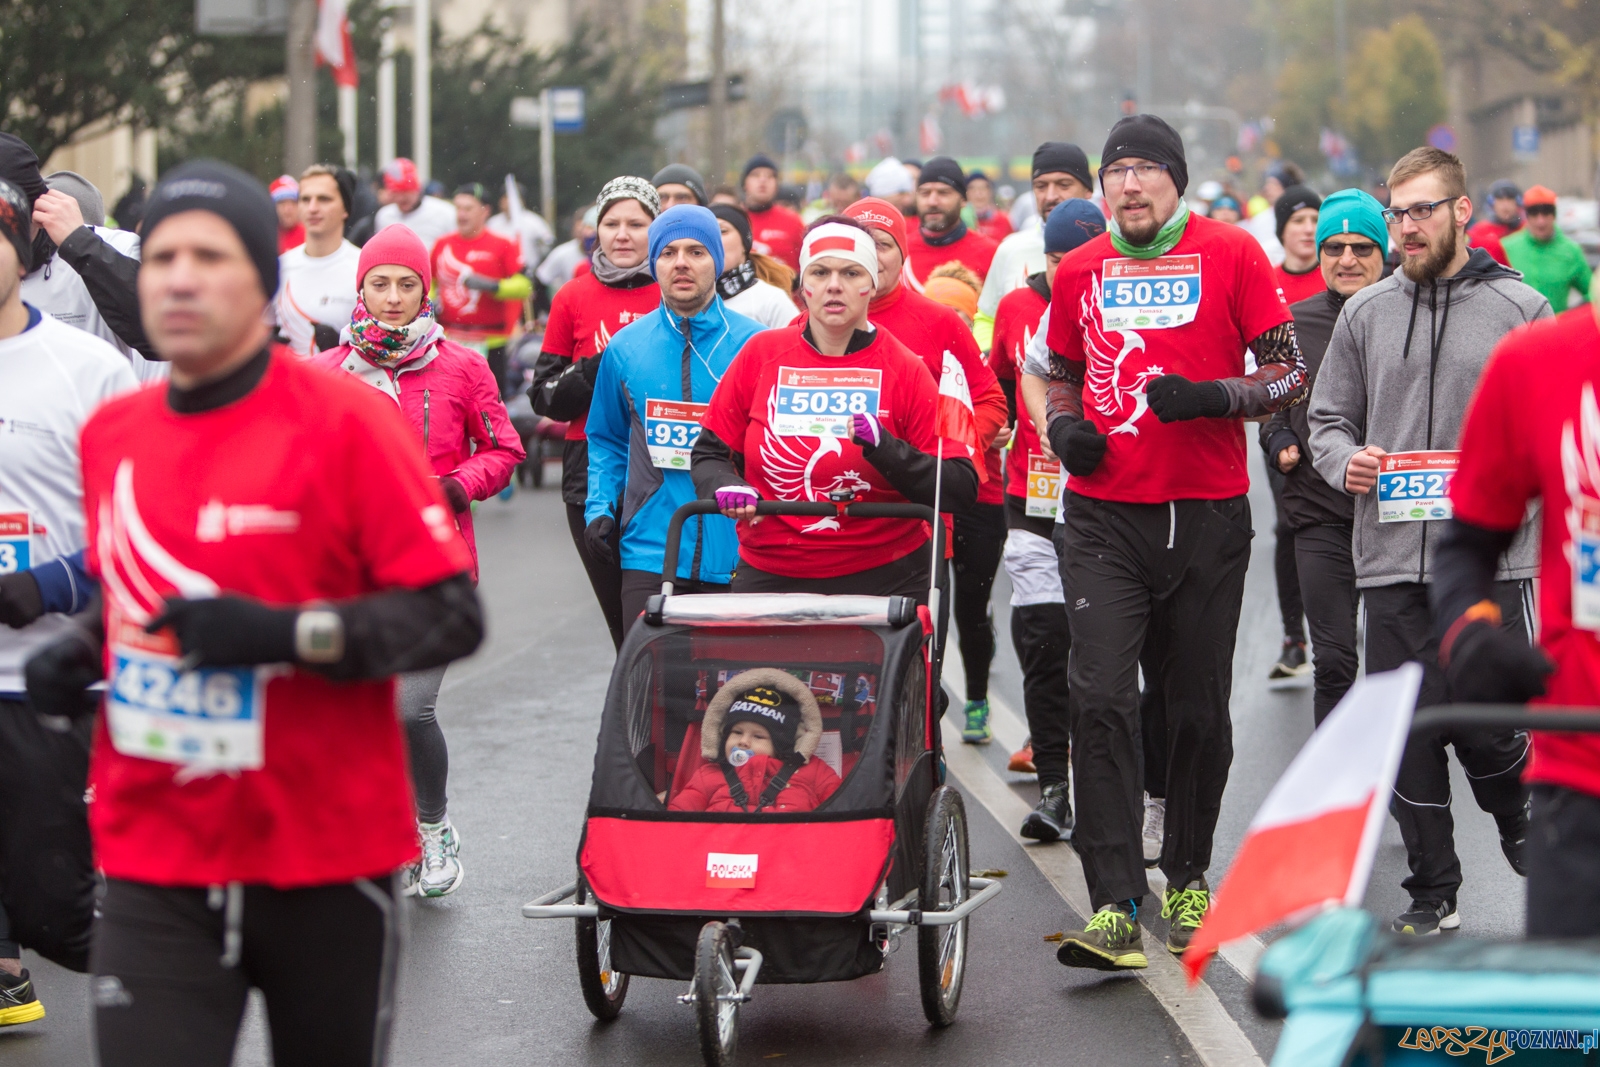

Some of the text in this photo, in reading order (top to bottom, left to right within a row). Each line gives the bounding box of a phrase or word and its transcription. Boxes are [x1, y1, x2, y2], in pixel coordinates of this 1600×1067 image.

[1105, 280, 1190, 305] E 5039
[780, 397, 788, 405] E
[790, 392, 867, 414] 5038
[648, 423, 703, 447] E 932
[1037, 477, 1060, 497] 97
[0, 543, 18, 575] 3
[116, 662, 242, 718] 4246
[729, 701, 785, 723] BATMAN
[710, 863, 752, 878] POLSKA
